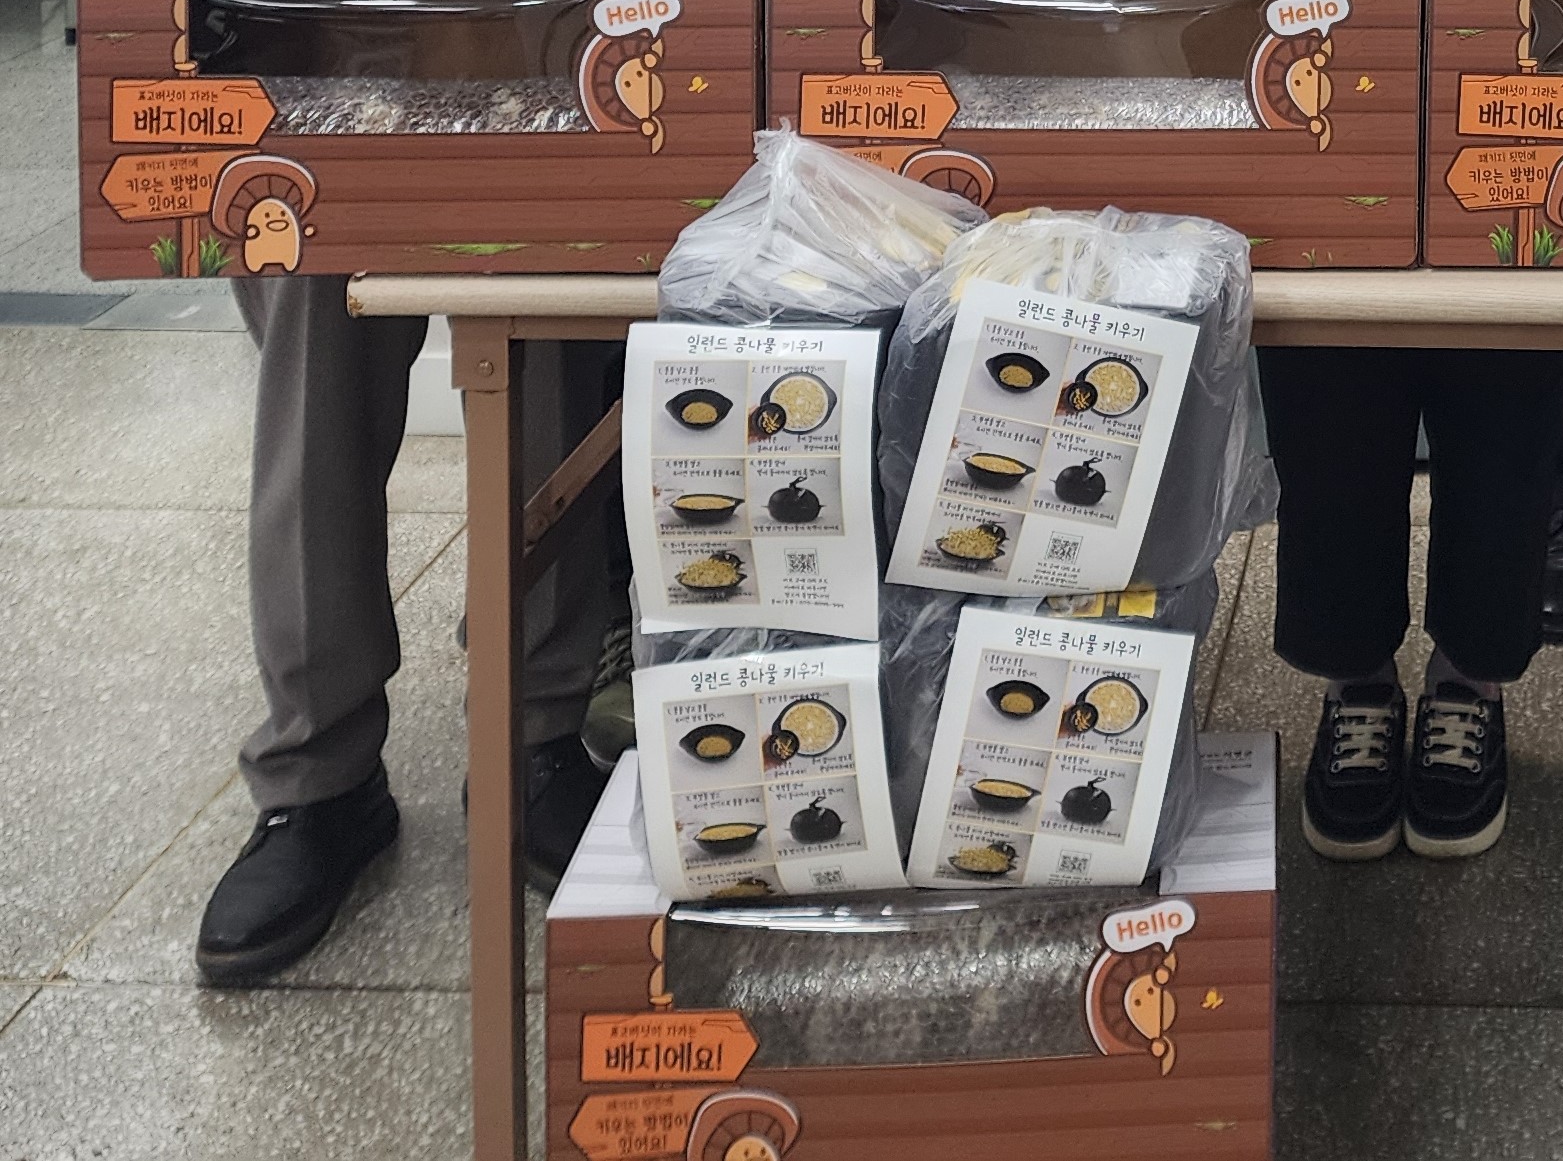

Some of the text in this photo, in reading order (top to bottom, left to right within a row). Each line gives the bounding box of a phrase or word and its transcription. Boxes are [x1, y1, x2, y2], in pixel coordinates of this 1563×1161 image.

[1278, 0, 1339, 26] Hello
[190, 91, 218, 102] 자라는
[826, 85, 903, 98] 표고버섯이 자라는
[1483, 85, 1559, 98] 표고버섯이 자라는
[134, 106, 243, 135] 배지에요!
[821, 100, 926, 130] 배지에요!
[126, 174, 213, 193] 키우는 방법이
[1469, 166, 1549, 184] 키우는 방법이
[149, 194, 193, 212] 있어요!
[1488, 186, 1530, 203] 있어요!
[1017, 299, 1146, 342] 일런드 콩나물 키우기
[1015, 626, 1141, 658] 일런드 콩나물 키우기
[691, 661, 824, 692] 일런드 콩나물 키우기
[1116, 910, 1183, 942] Hello
[605, 1041, 724, 1073] 배지에요!
